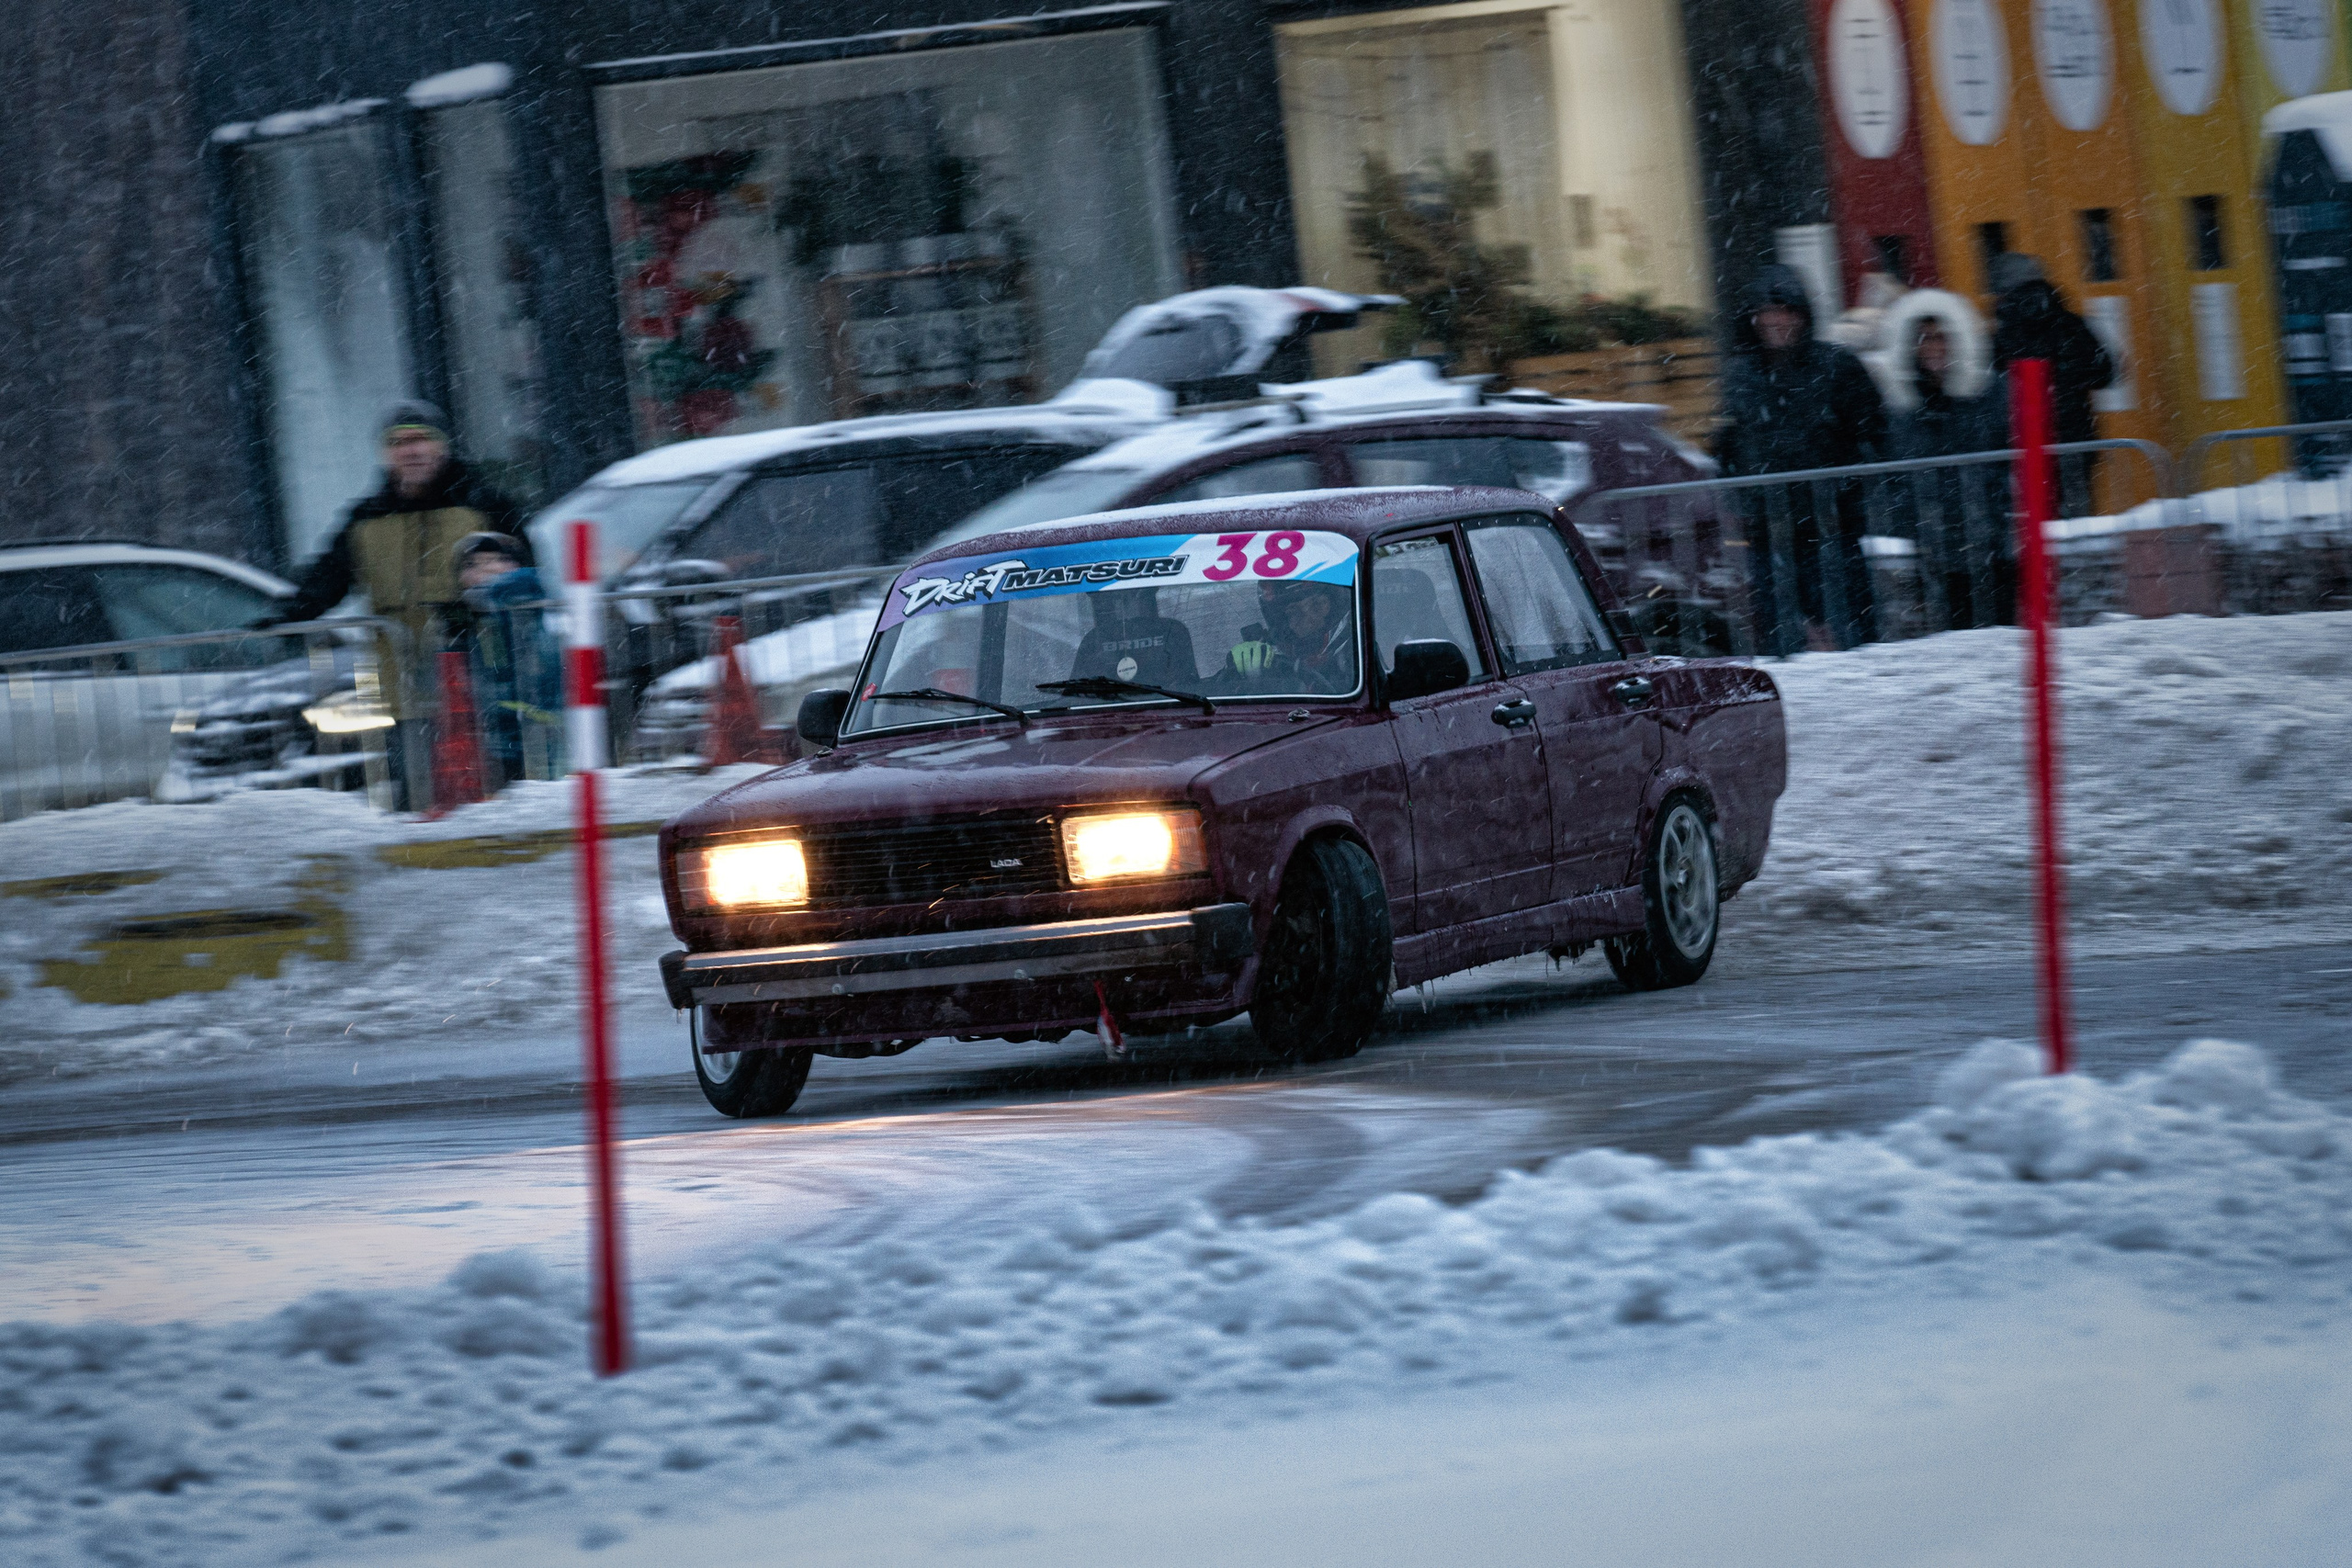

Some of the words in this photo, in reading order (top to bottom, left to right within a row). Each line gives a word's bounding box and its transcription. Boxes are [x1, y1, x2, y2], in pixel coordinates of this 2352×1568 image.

[1202, 530, 1306, 581] 38
[1001, 555, 1189, 592] MATSURI
[1102, 636, 1164, 652] BRIDE
[989, 858, 1023, 868] LADA
